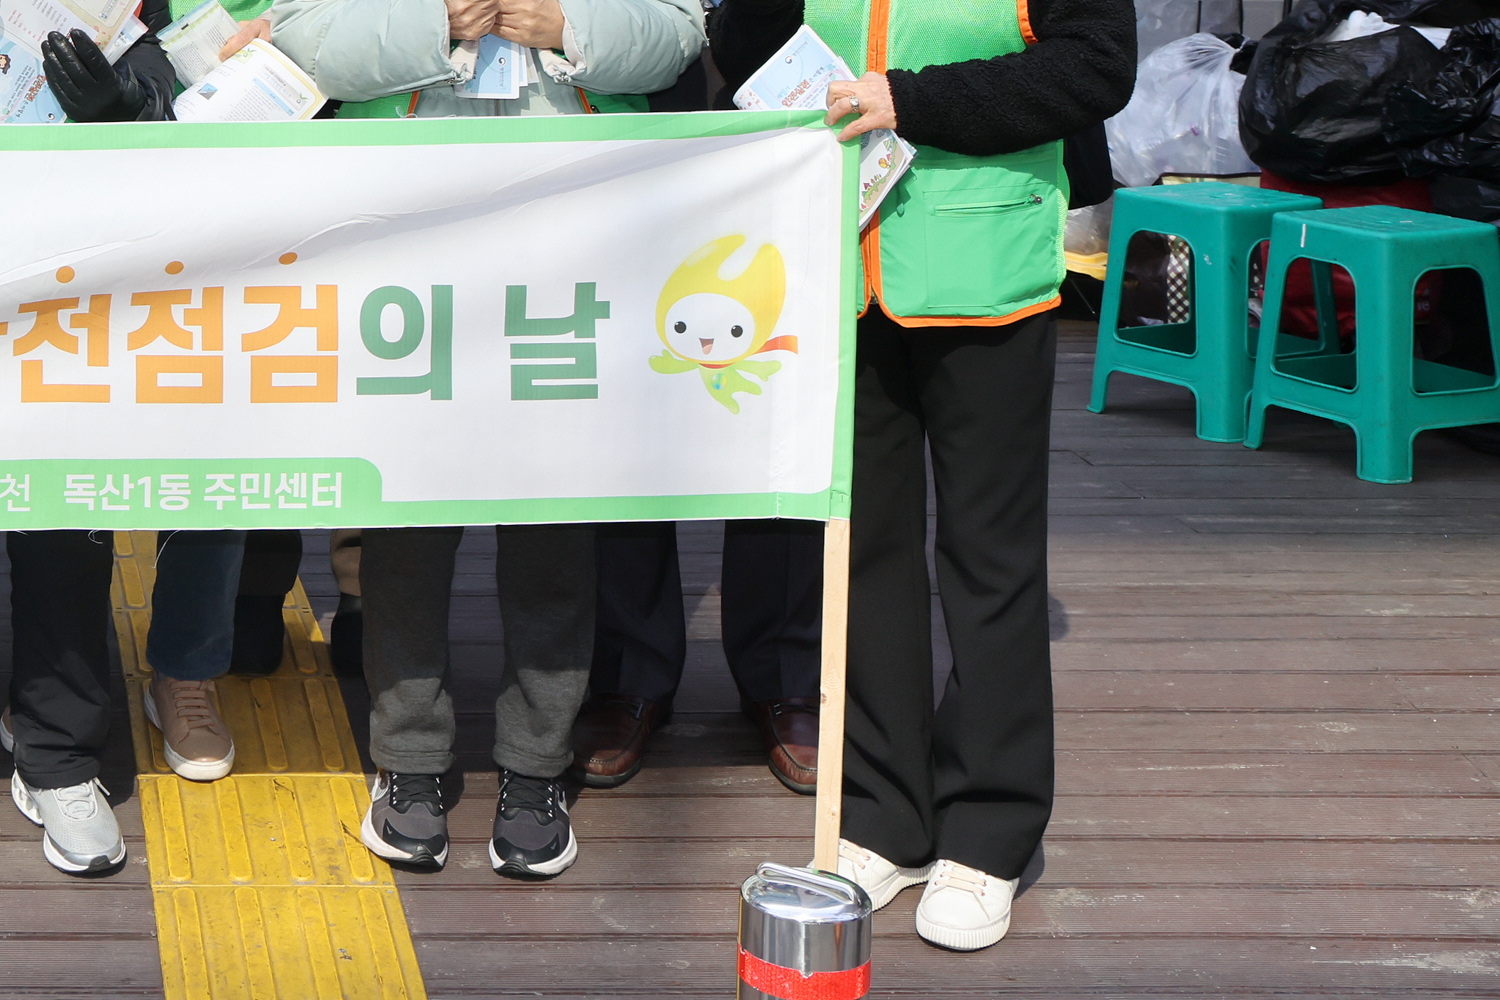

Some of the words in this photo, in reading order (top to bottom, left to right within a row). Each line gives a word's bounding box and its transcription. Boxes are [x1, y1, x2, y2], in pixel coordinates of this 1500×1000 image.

[503, 282, 611, 400] 날
[63, 473, 192, 513] 독산1동
[202, 471, 344, 511] 주민센터
